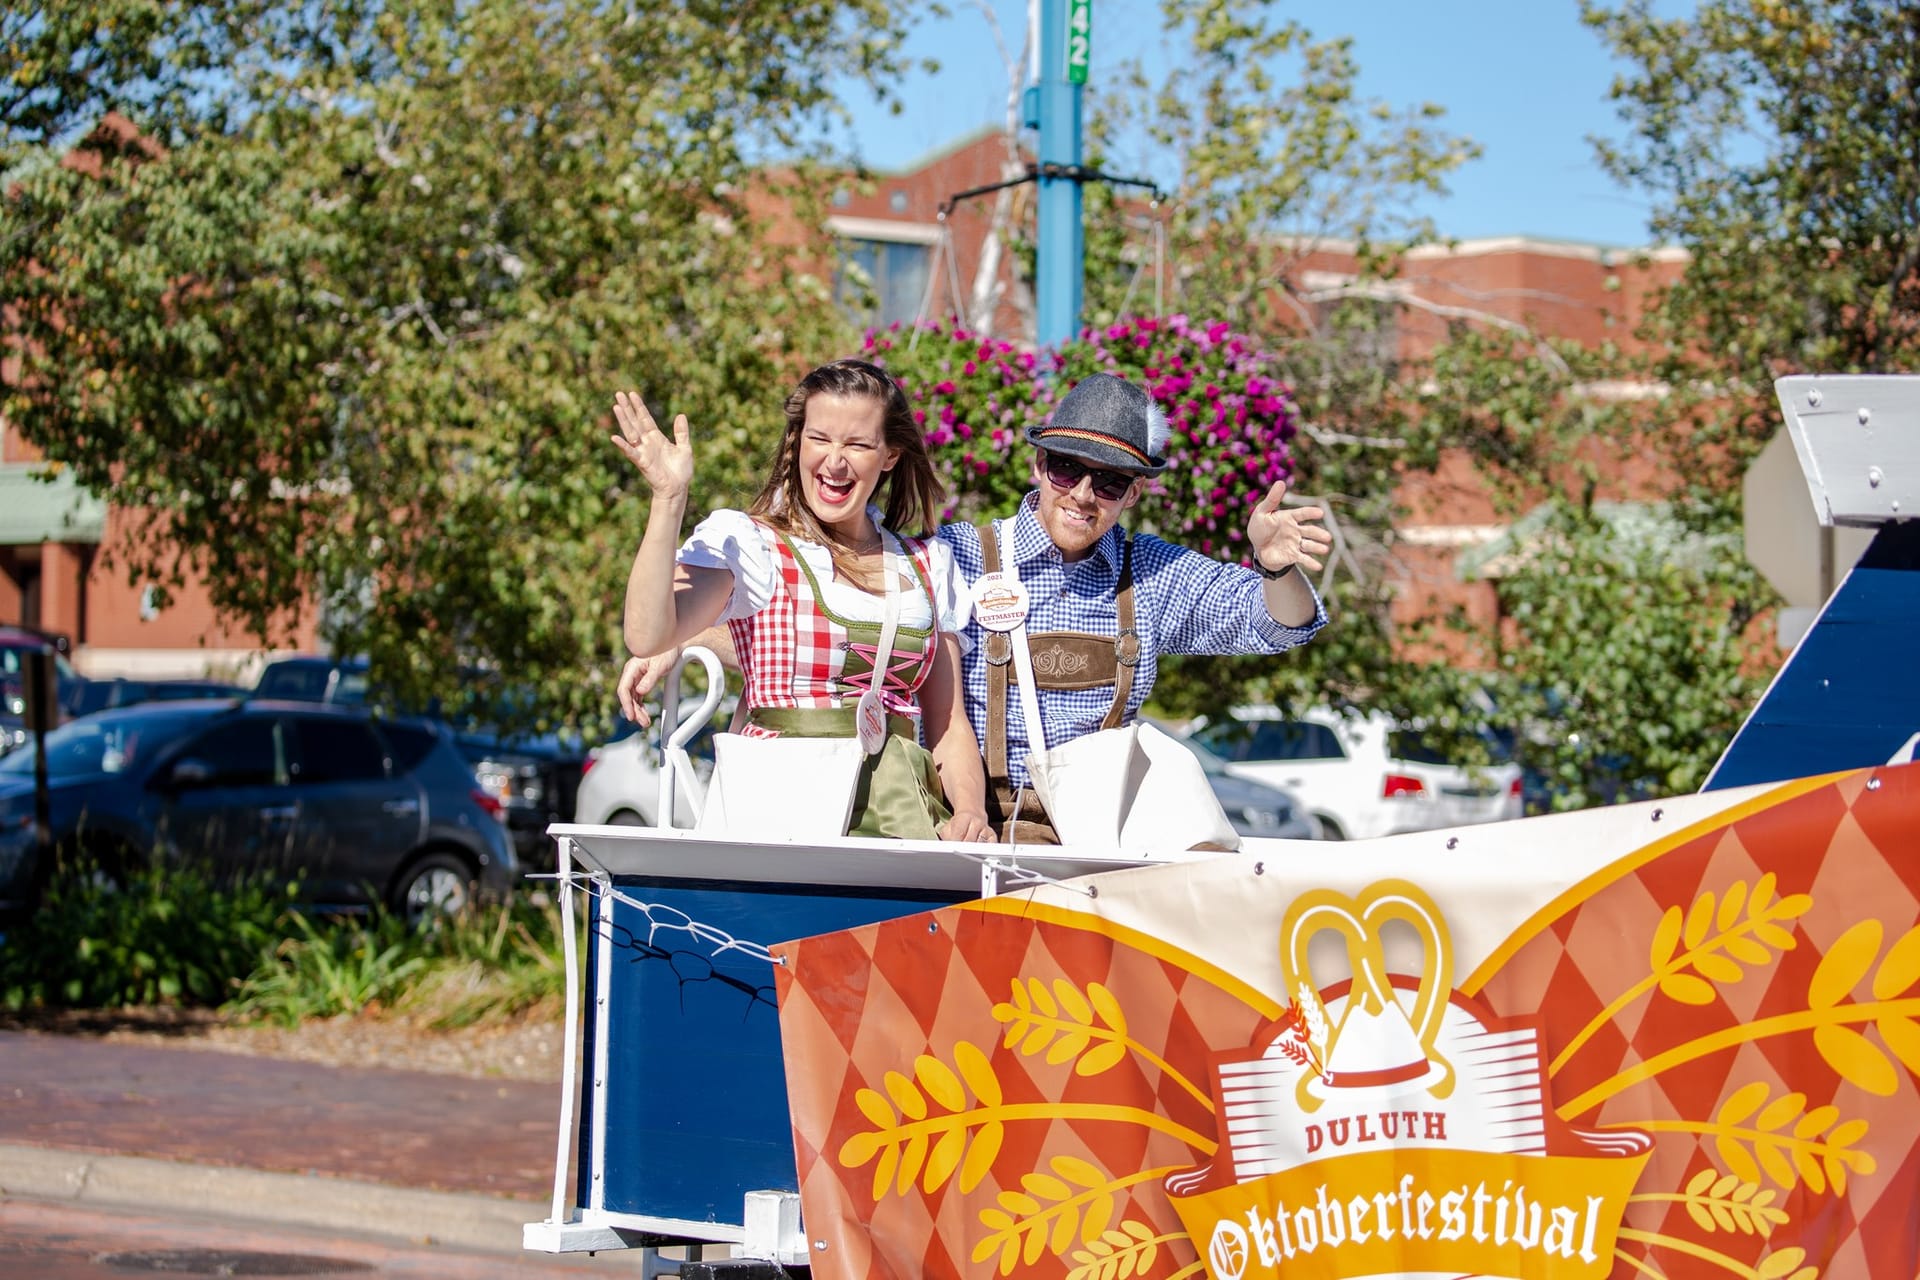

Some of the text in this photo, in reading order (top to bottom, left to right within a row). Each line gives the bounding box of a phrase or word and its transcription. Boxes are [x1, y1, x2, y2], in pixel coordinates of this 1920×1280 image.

[1071, 0, 1089, 66] 42
[987, 573, 1003, 581] 2021
[978, 611, 1026, 622] FESTMASTER
[1305, 1111, 1447, 1153] DULUTH
[1208, 1174, 1605, 1280] Oktoberfestival
